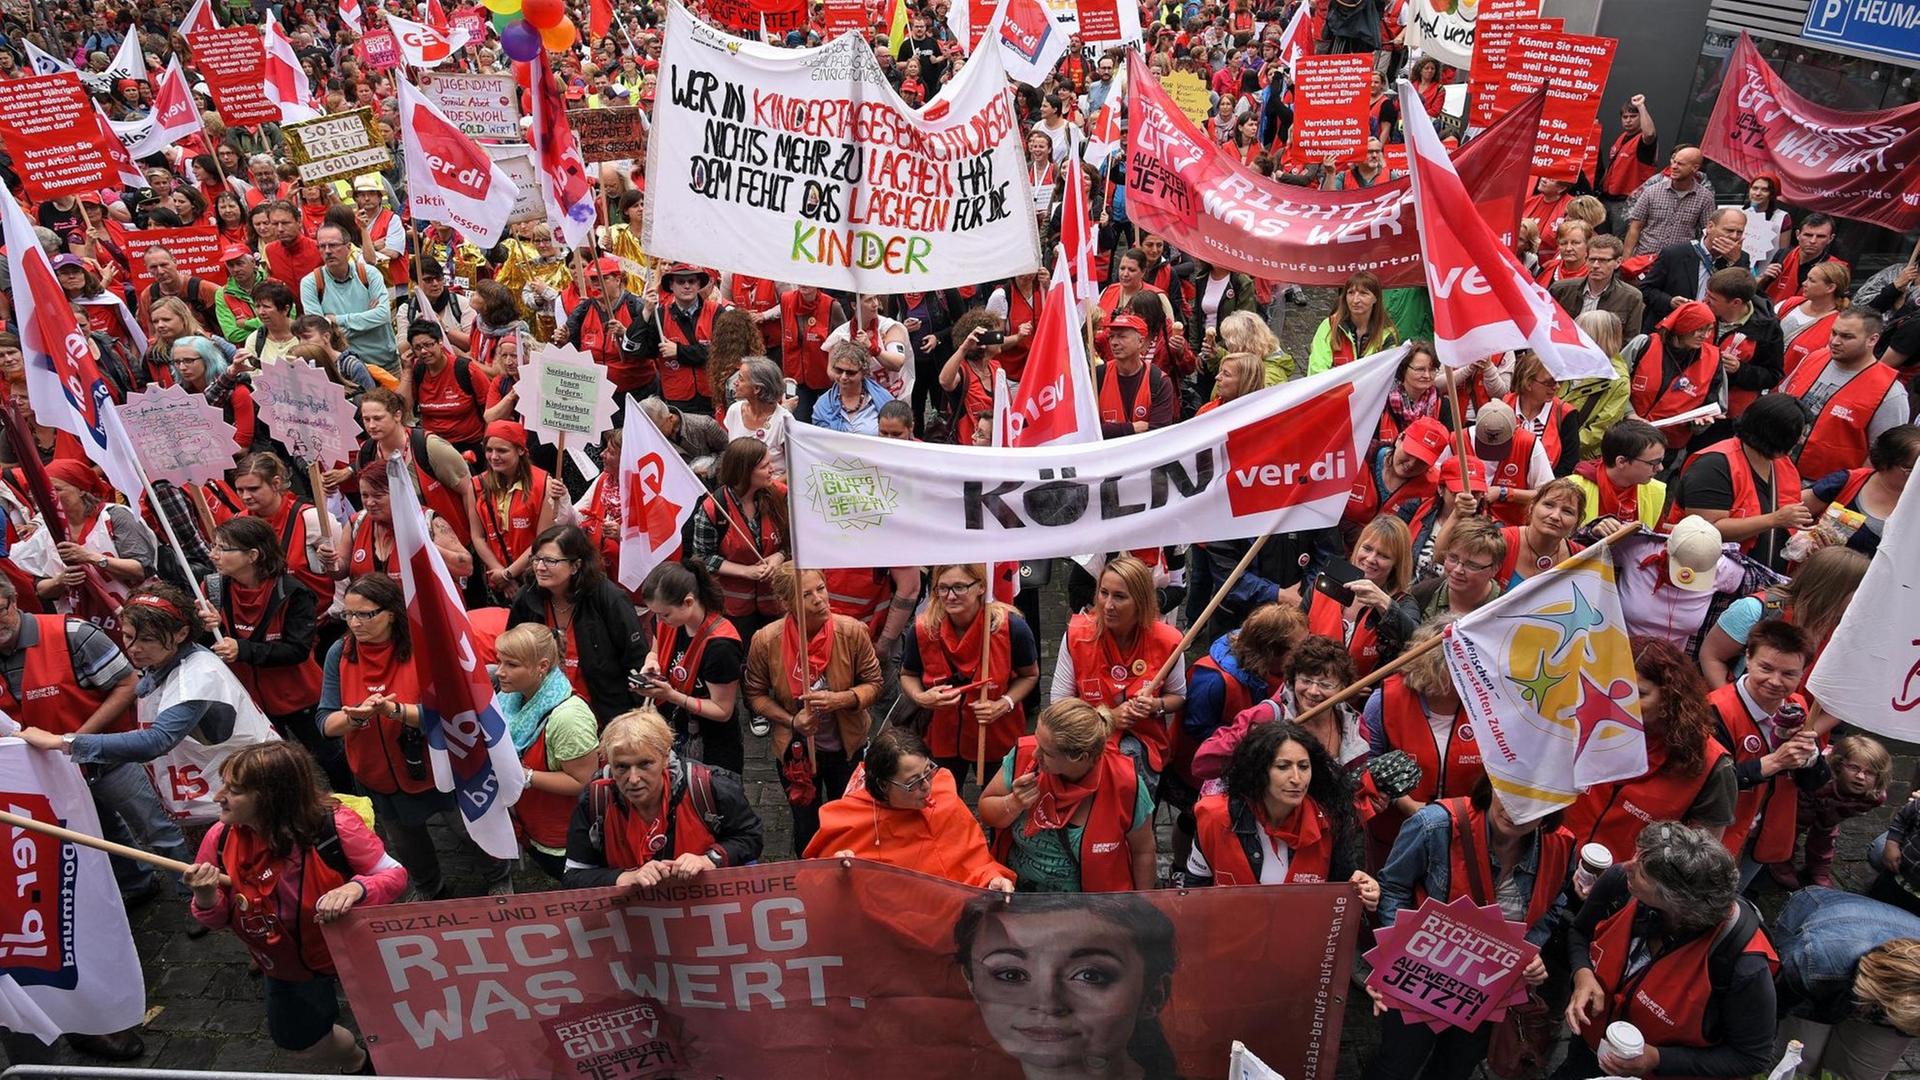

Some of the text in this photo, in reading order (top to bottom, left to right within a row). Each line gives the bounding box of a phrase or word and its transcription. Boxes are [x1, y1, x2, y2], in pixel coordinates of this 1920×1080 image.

[1820, 0, 1841, 27] P
[1003, 16, 1038, 50] ver.di
[1518, 37, 1606, 56] Können Sie nachts
[1524, 50, 1593, 67] nicht schlafen,
[1522, 62, 1545, 72] weil
[1546, 64, 1558, 73] sie
[1574, 70, 1589, 78] ein
[13, 78, 67, 92] oft haben Sie
[434, 78, 502, 94] JUGENDAMT
[1507, 72, 1599, 92] misshaneltes Baby
[16, 92, 41, 100] einem
[671, 64, 719, 116] WER
[722, 81, 746, 123] IN
[1546, 89, 1588, 102] müssen?
[4, 102, 38, 111] erklären
[41, 106, 62, 115] nicht
[63, 102, 84, 111] mehr
[11, 112, 80, 128] bei seinen Eltern
[21, 121, 75, 135] bleiben darf?
[304, 116, 362, 140] SOZIALE
[1346, 118, 1358, 126] Sie
[1552, 120, 1568, 130] Sie
[1317, 128, 1340, 136] Arbeit
[1342, 128, 1361, 136] auch
[1552, 134, 1583, 146] Arbeit
[25, 141, 93, 159] Verrichten Sie
[310, 134, 365, 158] ARBEIT
[1321, 138, 1361, 147] vermüllten
[1552, 146, 1571, 157] und
[1774, 130, 1839, 168] WAS
[25, 162, 46, 171] Ihre
[48, 156, 76, 167] Arbeit
[79, 151, 101, 161] auch
[324, 156, 359, 173] GOLD
[362, 152, 386, 165] wert
[704, 119, 995, 198] NICHTS MEHR ZU LACHEN HAT
[30, 172, 44, 181] oft
[57, 161, 107, 175] vermüllten
[42, 172, 103, 190] Wohnungen?
[690, 156, 732, 201] DEM
[736, 168, 794, 213] FEHLT
[800, 180, 841, 223] DAS
[847, 187, 950, 232] LÄCHELN
[952, 194, 986, 232] FÜR
[1204, 189, 1403, 245] WAS WER
[128, 240, 160, 248] Müssen
[176, 234, 218, 244] unentwegt
[188, 246, 200, 254] ein
[791, 220, 932, 275] KINDER
[196, 265, 220, 274] stirbt?
[824, 481, 860, 496] GUT
[963, 448, 1347, 530] KÖLN ver.di
[1462, 637, 1495, 691] Menschen
[1452, 640, 1518, 763] Wir gestalten Zukunft
[370, 912, 480, 934] SOZIAL-
[489, 907, 537, 923] UND
[376, 897, 808, 993] RICHTIG
[1421, 914, 1520, 969] RICHTIG
[1405, 930, 1486, 977] GUT
[1304, 896, 1347, 1080] ziale-berufe-aufwerten.de
[1394, 956, 1490, 1004] AUFWERTEN
[392, 956, 866, 1050] WAS WERT.
[1382, 966, 1481, 1021] JETZT!
[556, 1008, 656, 1042] RICHTIG
[563, 1024, 634, 1060] GUT
[576, 1041, 671, 1071] AUFWERTEN
